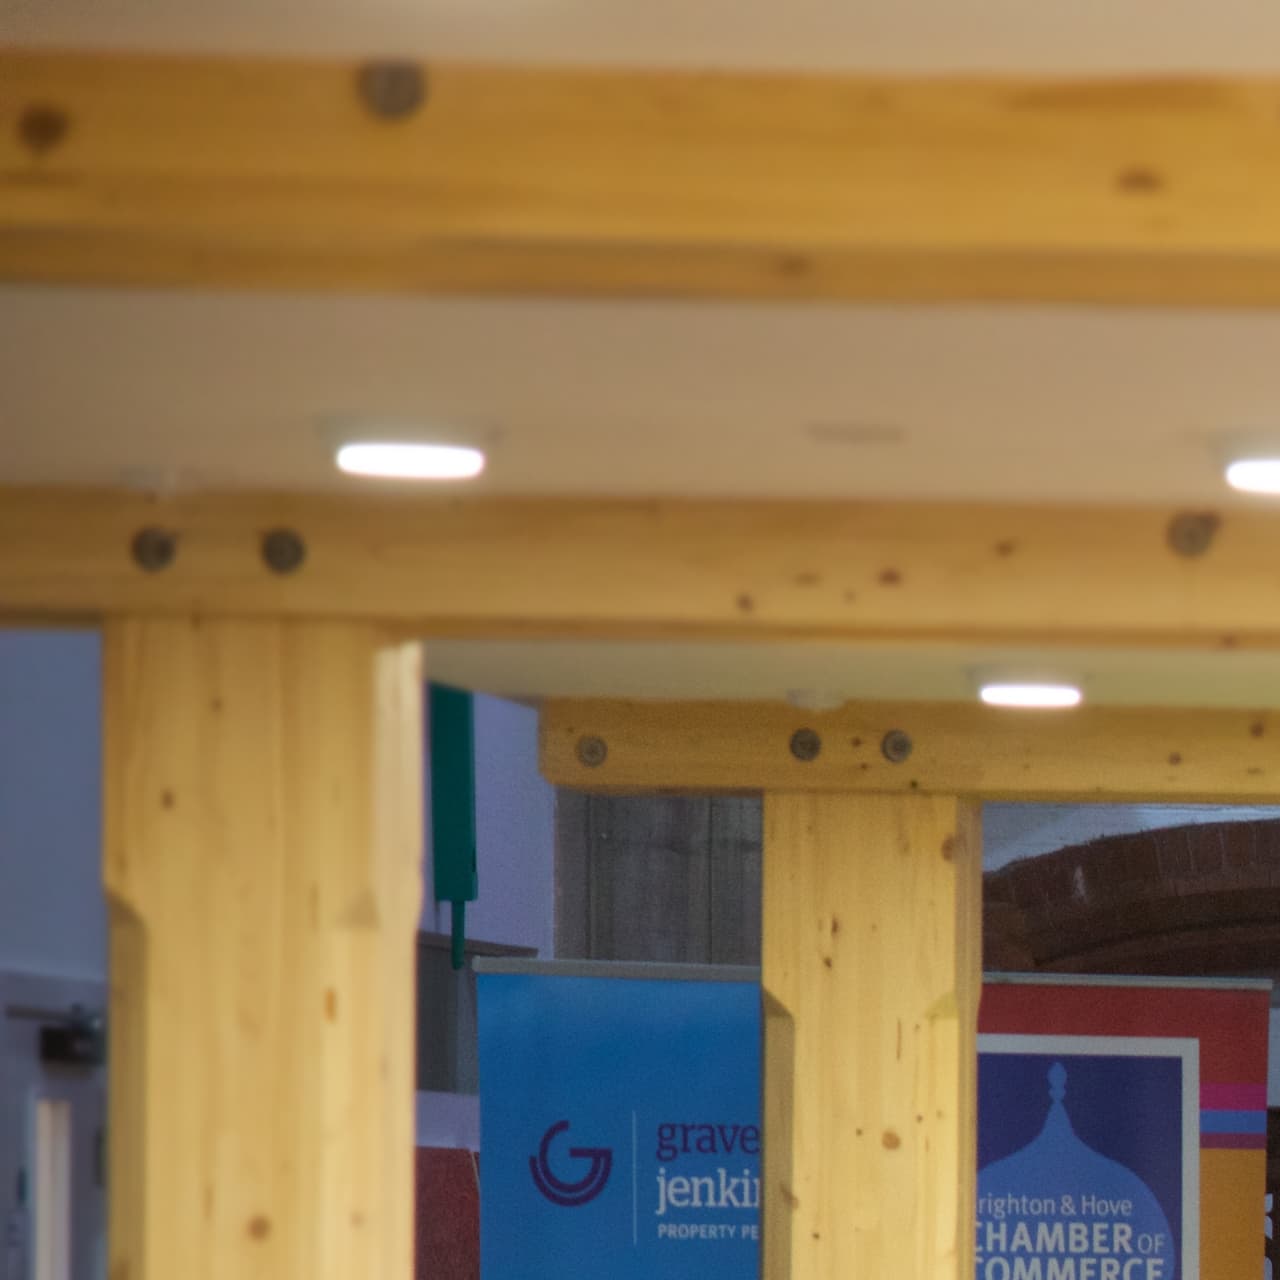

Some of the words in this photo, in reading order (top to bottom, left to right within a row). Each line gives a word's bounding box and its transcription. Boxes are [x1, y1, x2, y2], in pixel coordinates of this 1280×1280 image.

[655, 1122, 760, 1162] grave
[655, 1166, 760, 1216] jenki
[976, 1191, 1056, 1219] righton
[1060, 1194, 1076, 1214] &
[1081, 1194, 1133, 1216] Hove
[658, 1223, 737, 1240] PROPERTY
[1137, 1232, 1166, 1255] OF
